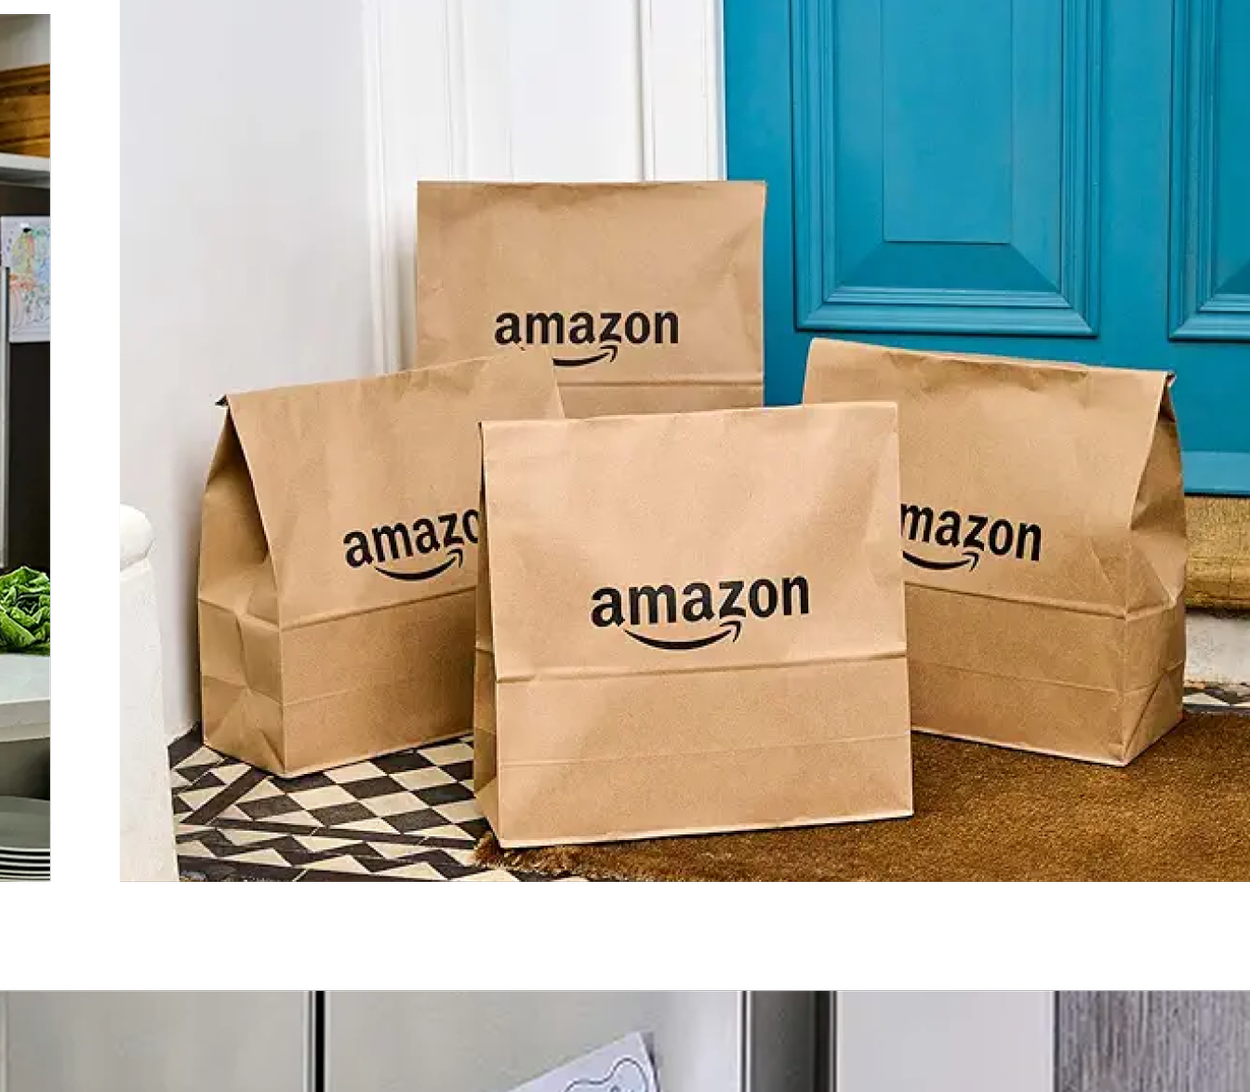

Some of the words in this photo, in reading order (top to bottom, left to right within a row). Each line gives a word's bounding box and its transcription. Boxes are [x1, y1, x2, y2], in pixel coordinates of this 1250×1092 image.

[494, 311, 679, 345] amazon
[343, 509, 479, 568] amazo
[900, 503, 1042, 562] mazon
[591, 575, 809, 628] amazon
